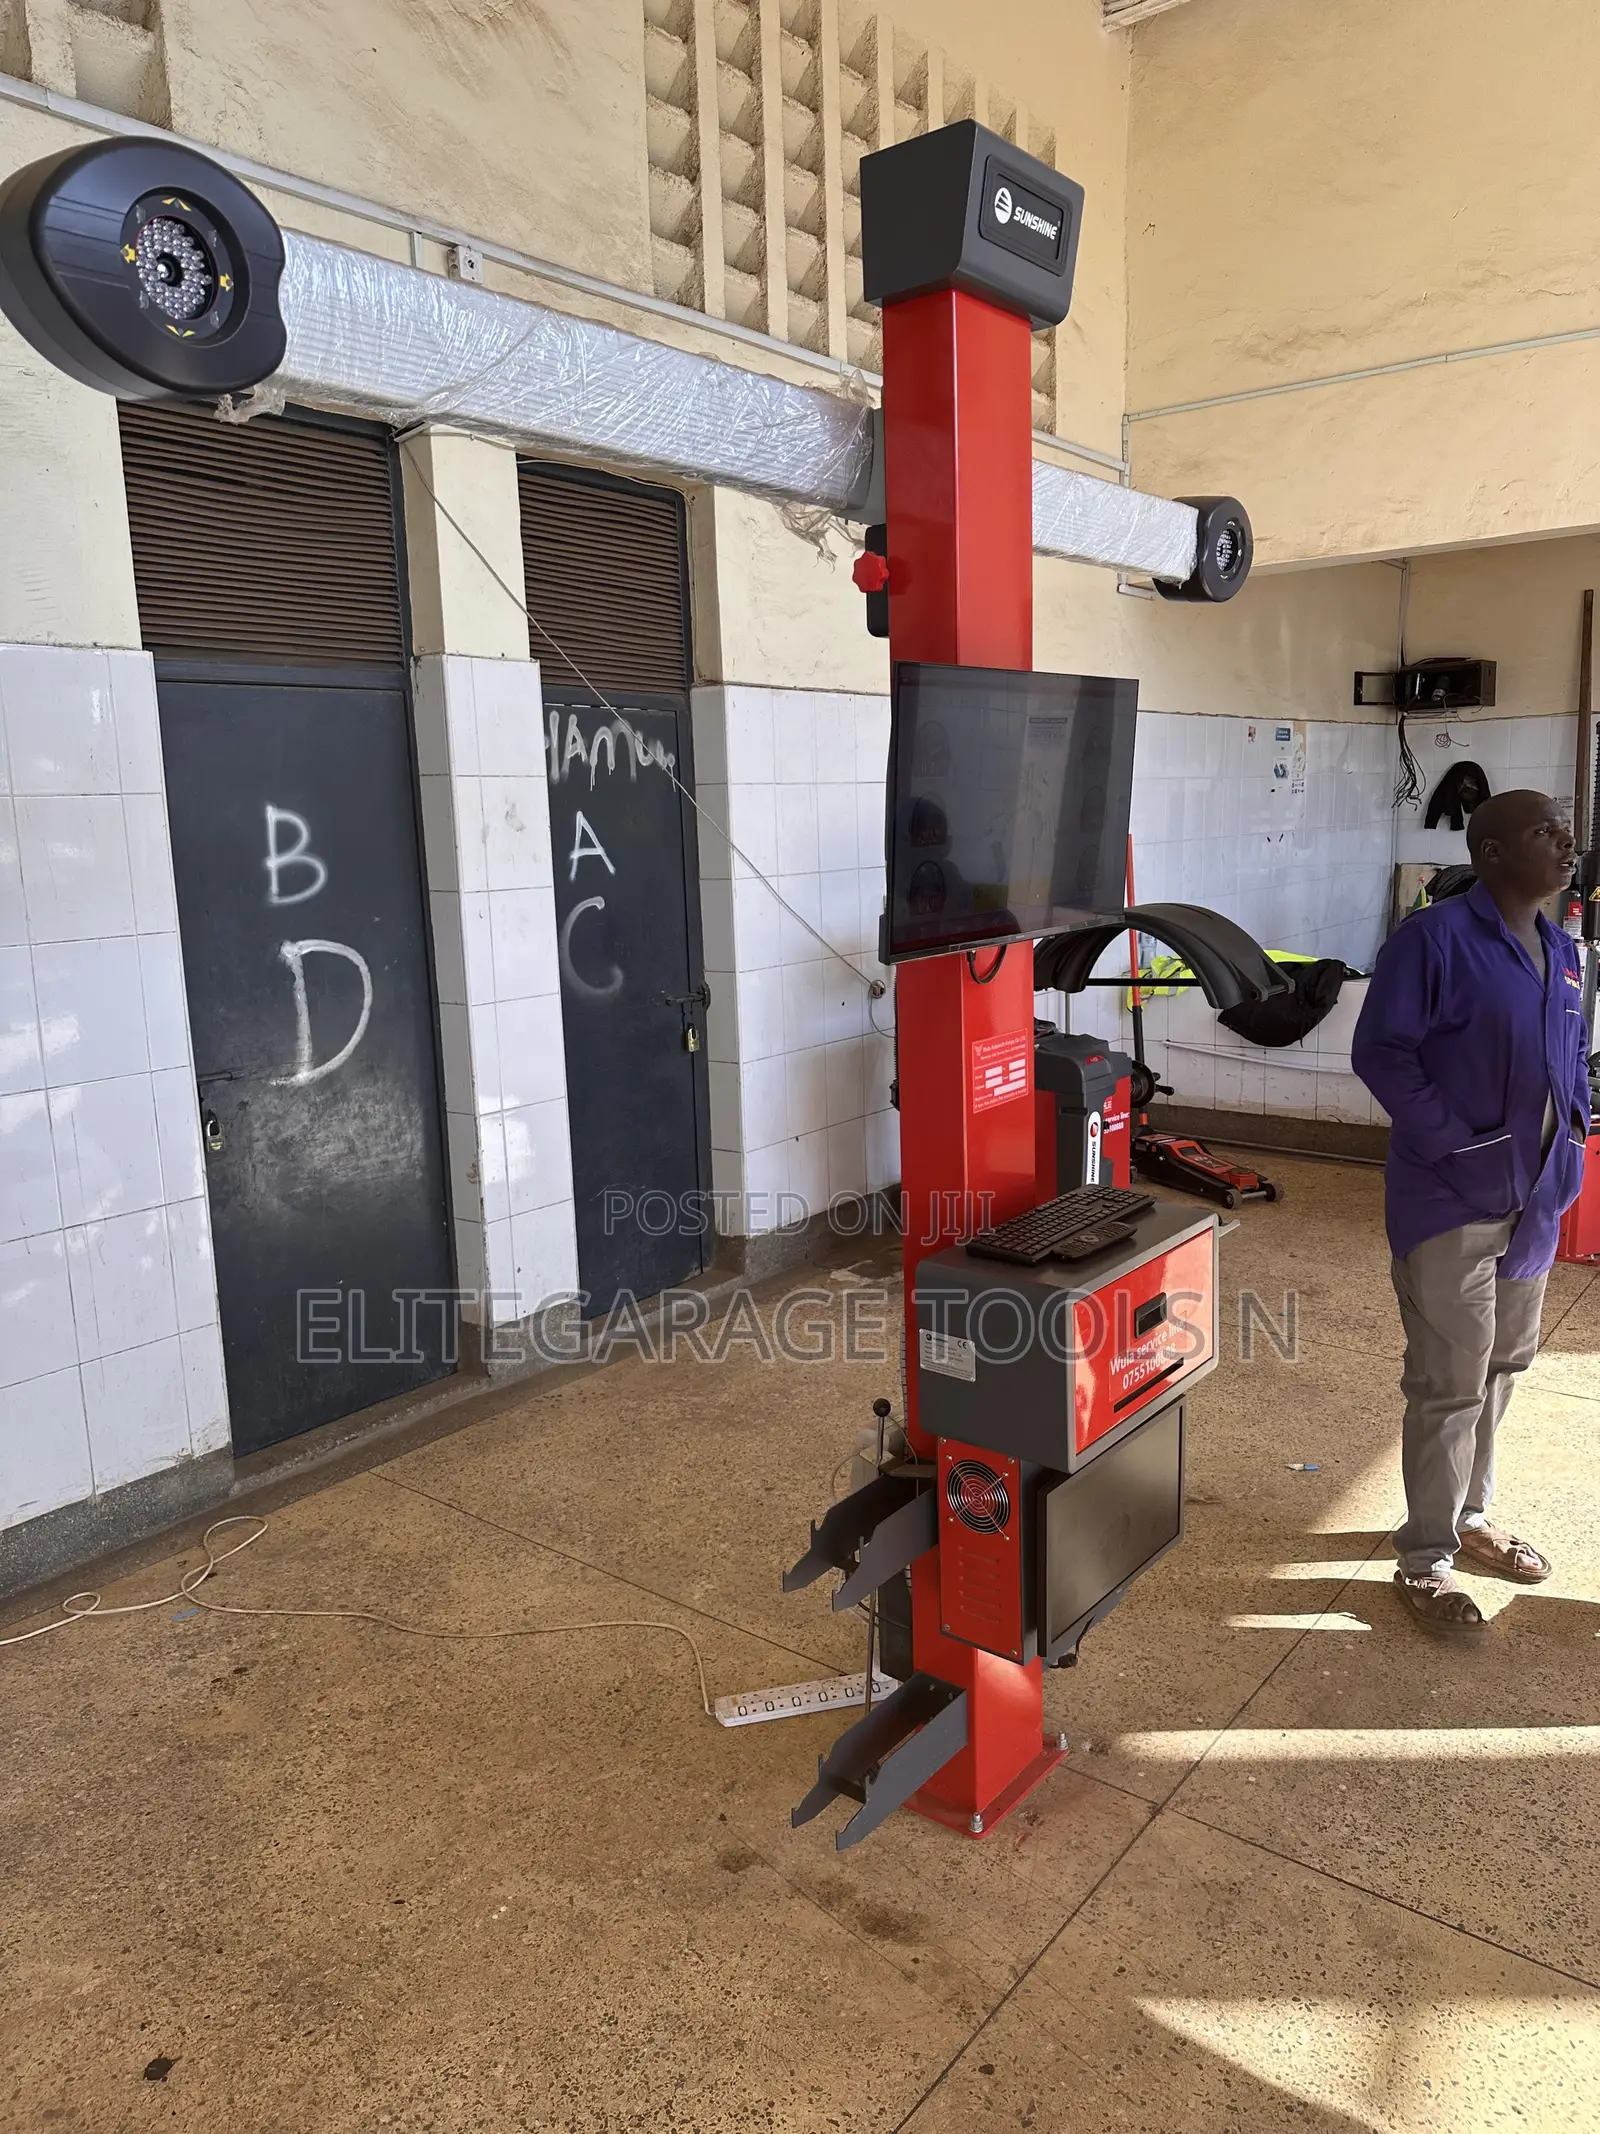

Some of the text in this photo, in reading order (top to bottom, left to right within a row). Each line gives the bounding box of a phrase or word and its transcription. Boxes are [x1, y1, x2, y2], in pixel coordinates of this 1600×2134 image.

[1013, 206, 1058, 240] SUNSHINE
[265, 803, 327, 905] B
[568, 811, 615, 882] A
[561, 896, 624, 996] C
[271, 938, 373, 1086] D
[1110, 1350, 1135, 1376] Wula
[1136, 1331, 1167, 1359] service
